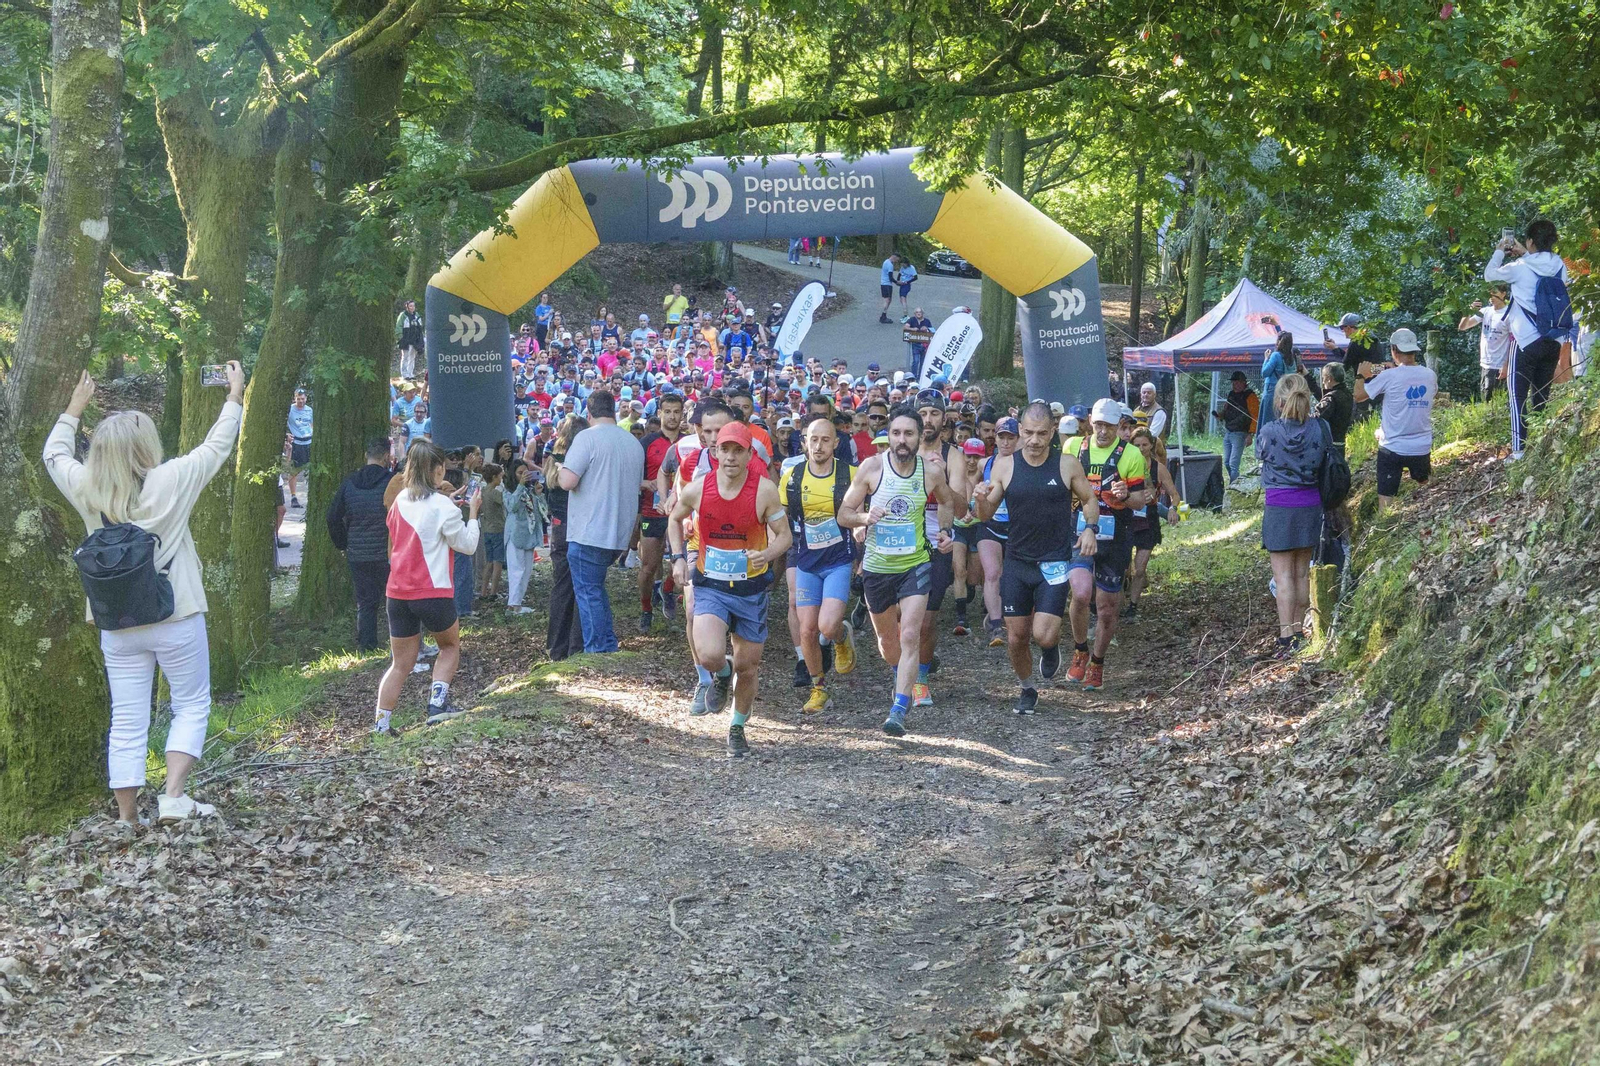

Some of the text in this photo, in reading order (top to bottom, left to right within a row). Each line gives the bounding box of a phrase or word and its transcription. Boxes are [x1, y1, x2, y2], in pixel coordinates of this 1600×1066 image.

[744, 170, 875, 197] Deputación
[745, 194, 876, 214] Pontevedra
[1039, 321, 1099, 339] Deputación
[941, 335, 958, 358] Entre
[947, 325, 971, 361] Castelos
[1040, 334, 1100, 349] Pontevedra
[438, 350, 501, 365] Deputación
[438, 363, 502, 374] Pontevedra
[811, 531, 832, 543] 396
[883, 536, 906, 547] 454
[714, 560, 736, 573] 347
